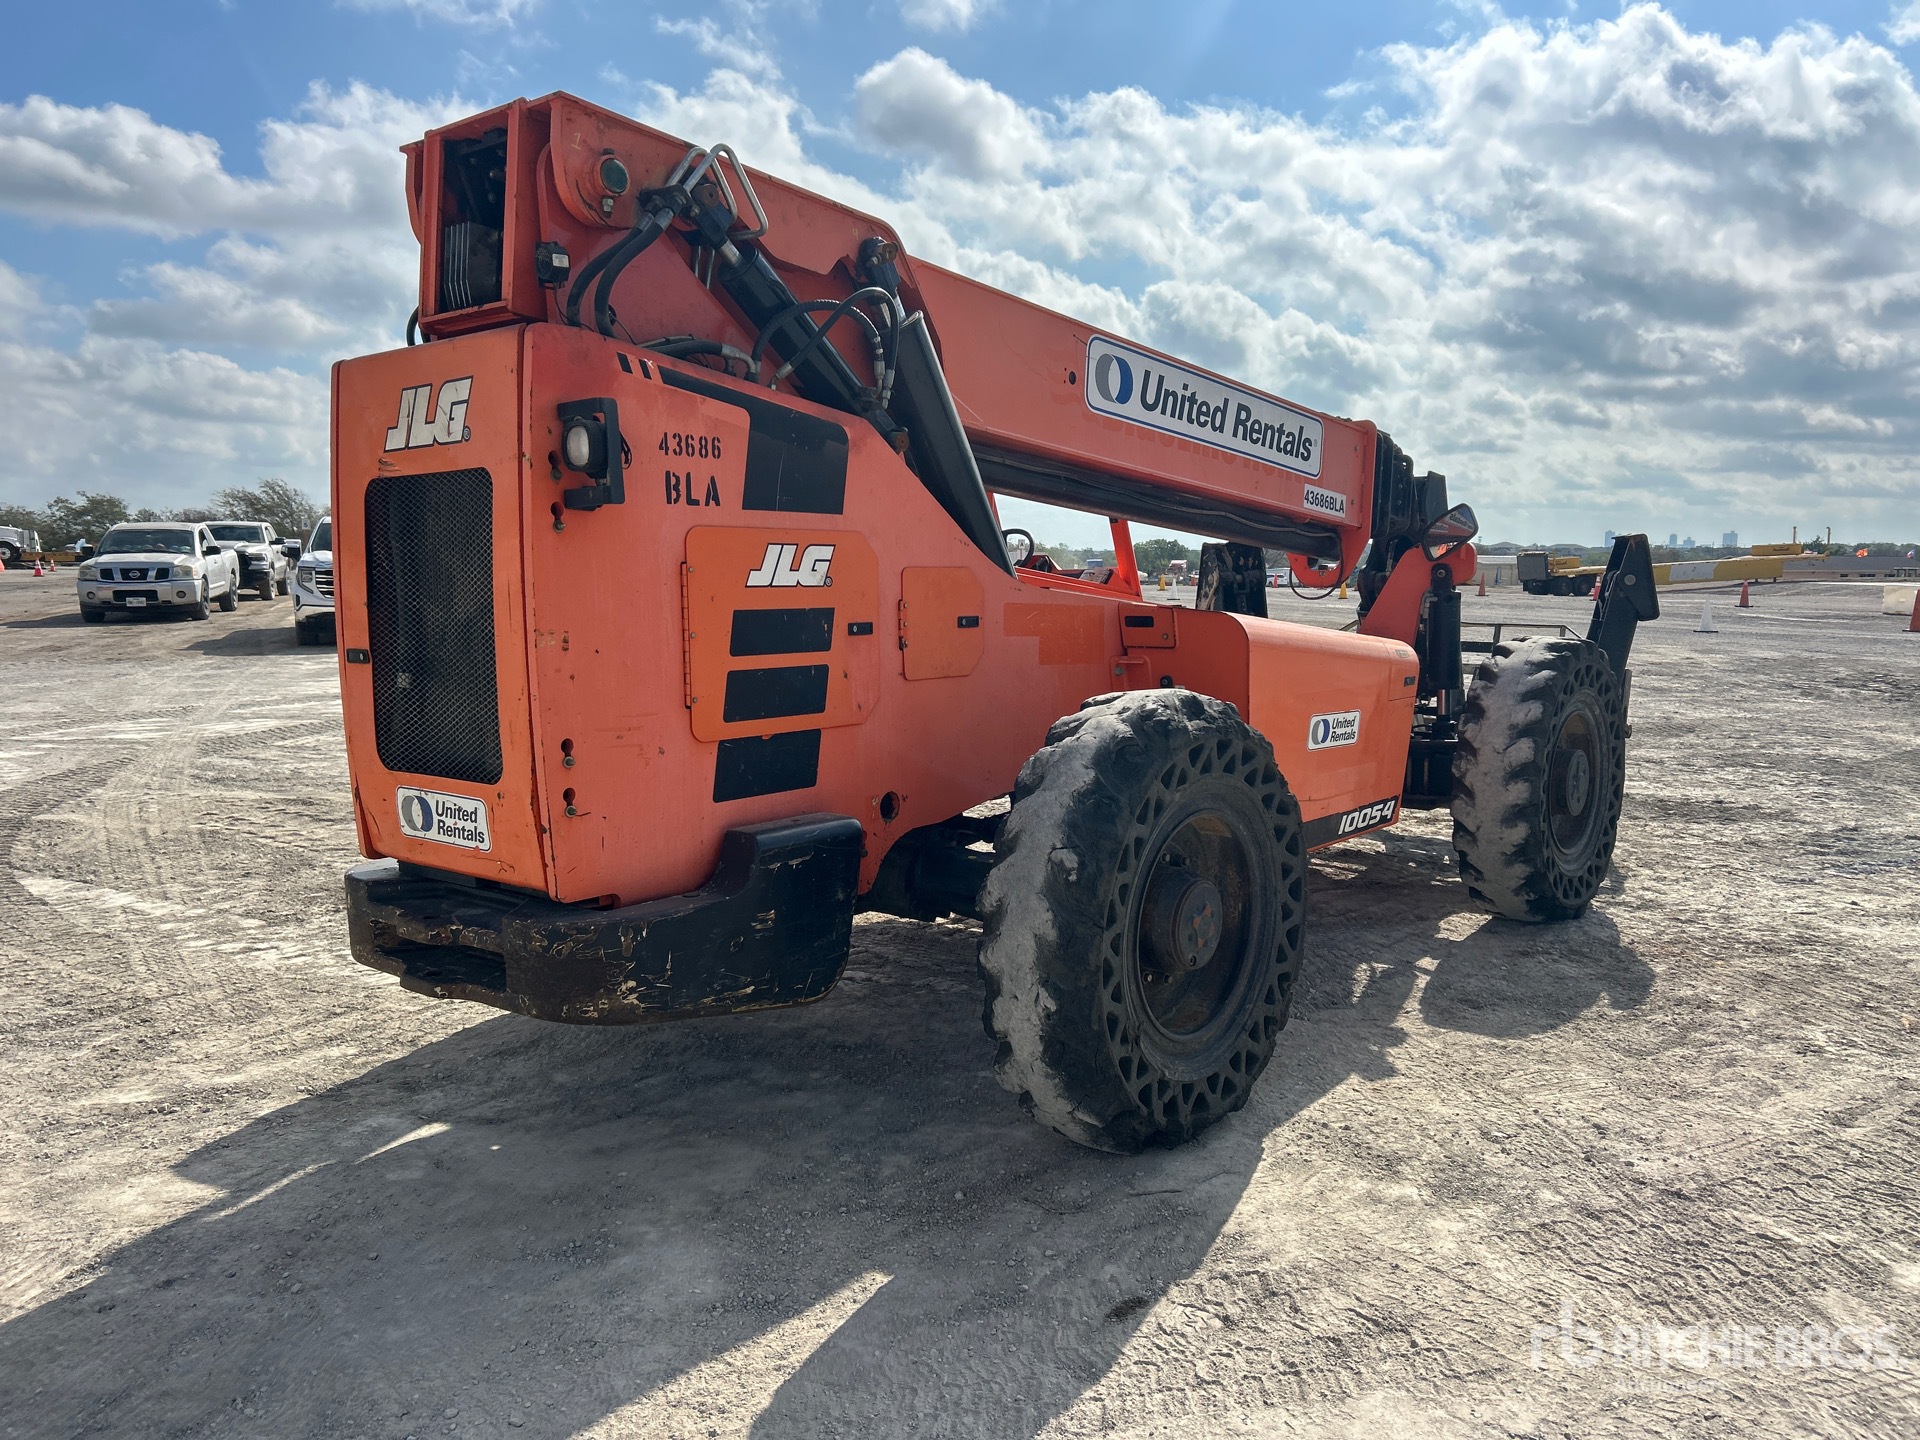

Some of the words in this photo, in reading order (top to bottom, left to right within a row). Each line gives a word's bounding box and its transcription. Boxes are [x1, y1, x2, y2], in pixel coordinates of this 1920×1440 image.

[384, 375, 474, 453] JLG
[1140, 369, 1230, 434] United
[1232, 402, 1313, 462] Rentals
[659, 432, 721, 459] 43686
[665, 470, 721, 506] BLA
[1304, 490, 1345, 513] 43686BLA
[745, 543, 836, 588] JLG
[1330, 729, 1356, 742] Rentals
[1332, 716, 1356, 730] United
[435, 800, 478, 823] United
[1338, 800, 1395, 834] 10054
[437, 819, 485, 843] Rentals
